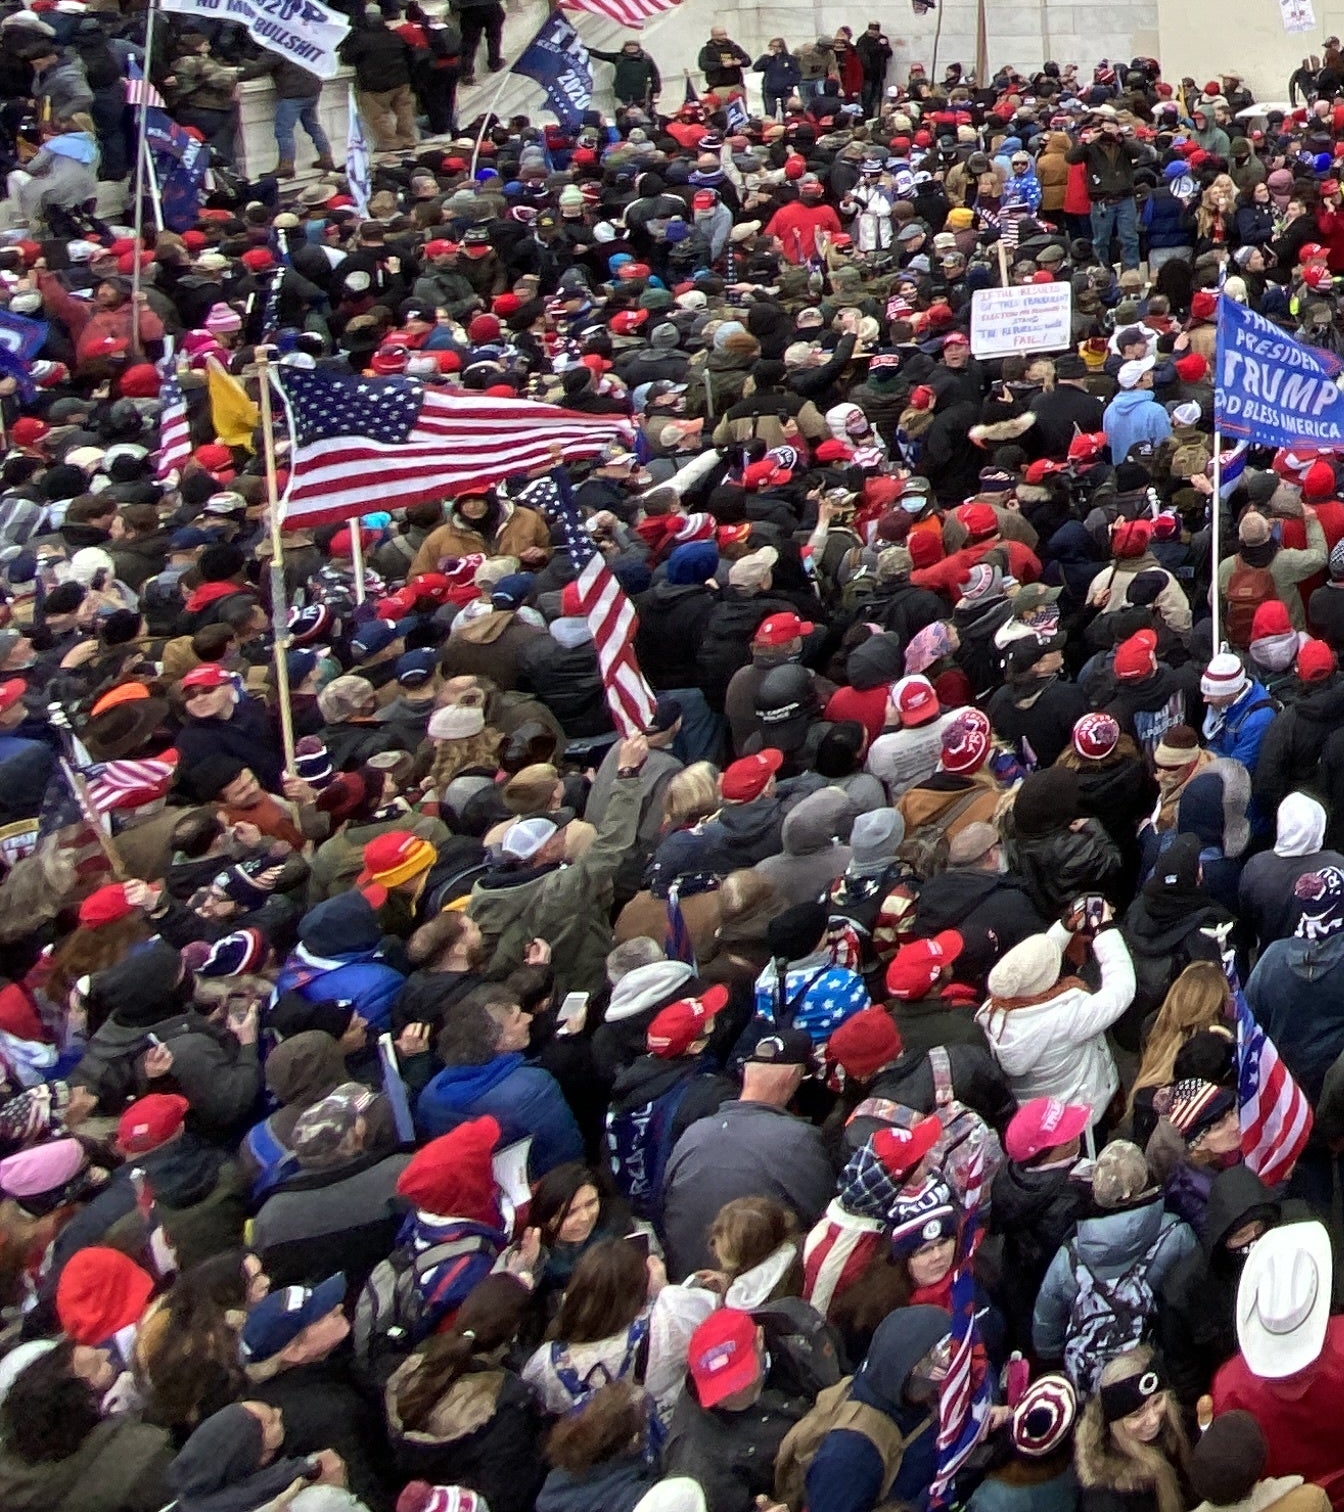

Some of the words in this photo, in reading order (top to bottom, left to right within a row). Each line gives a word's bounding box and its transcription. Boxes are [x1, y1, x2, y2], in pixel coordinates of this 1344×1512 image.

[252, 15, 327, 63] BULLSHIT
[557, 67, 592, 110] 2020
[1236, 328, 1325, 373] PRESIDEN
[1223, 349, 1338, 416] TRUMP
[1242, 399, 1280, 427] BLESS
